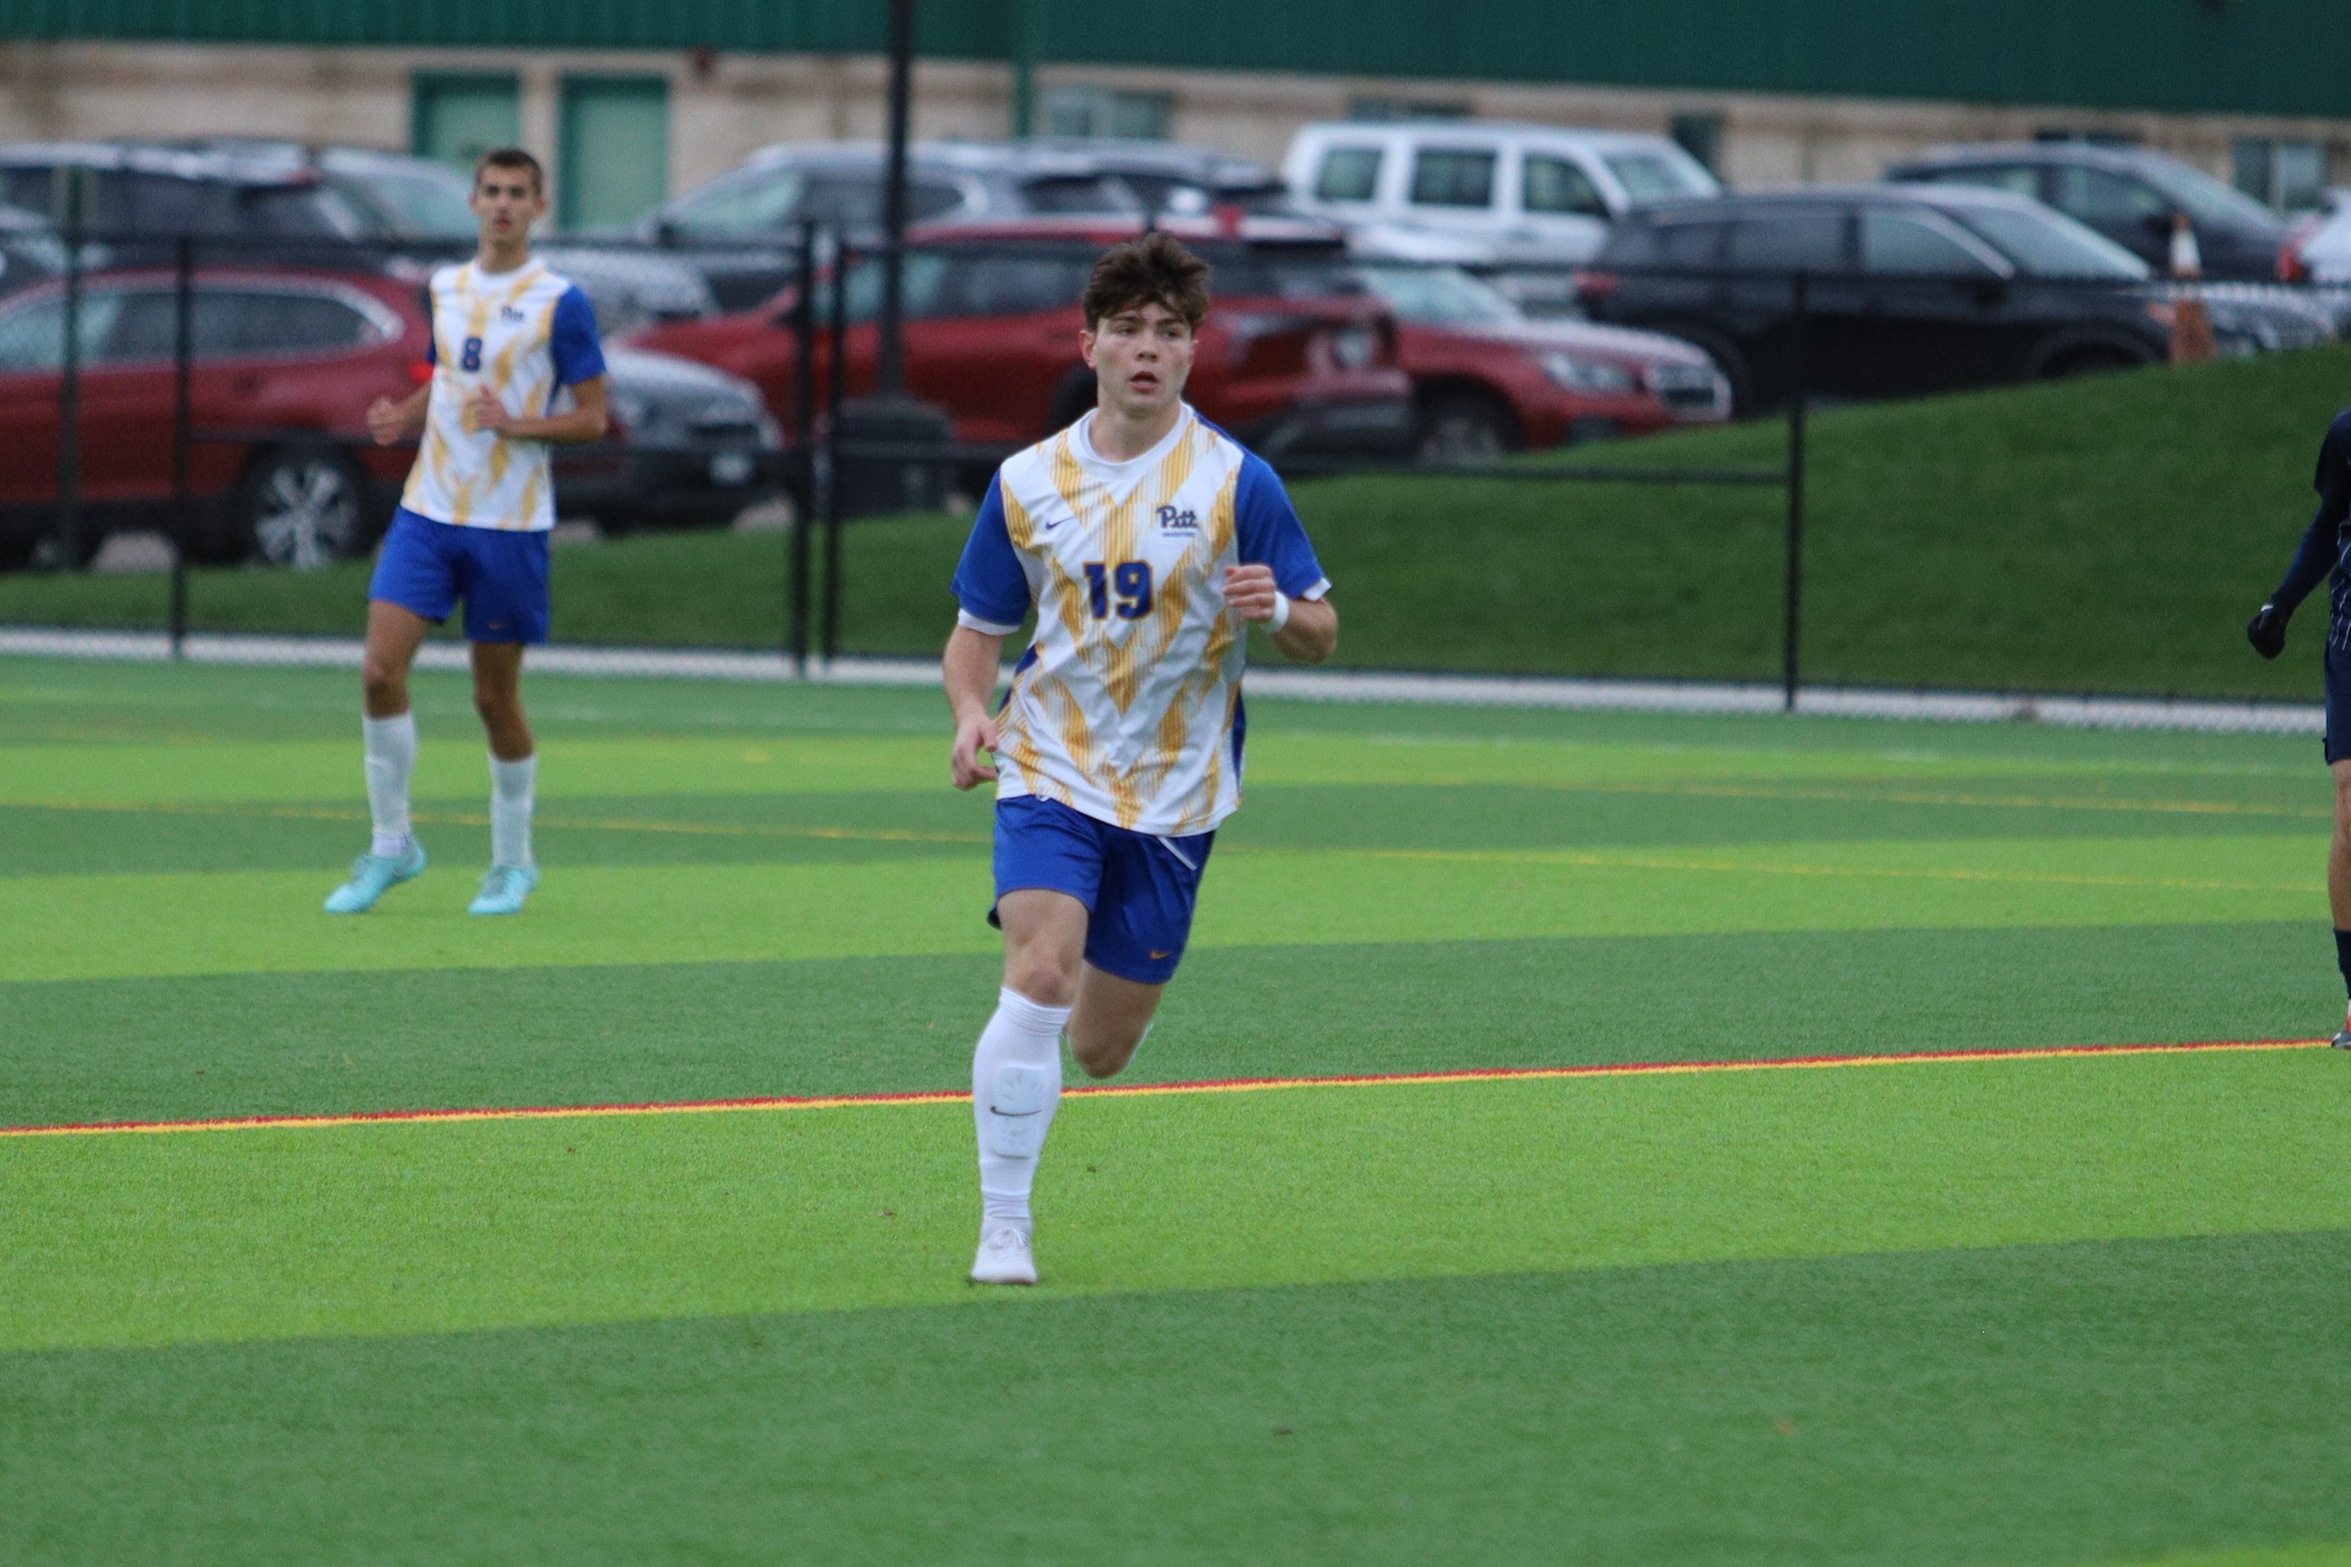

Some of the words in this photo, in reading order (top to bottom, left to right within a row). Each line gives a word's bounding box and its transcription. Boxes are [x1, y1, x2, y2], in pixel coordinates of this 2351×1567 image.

[462, 336, 482, 372] 8
[1156, 505, 1198, 528] Pitt
[1083, 561, 1153, 621] 19
